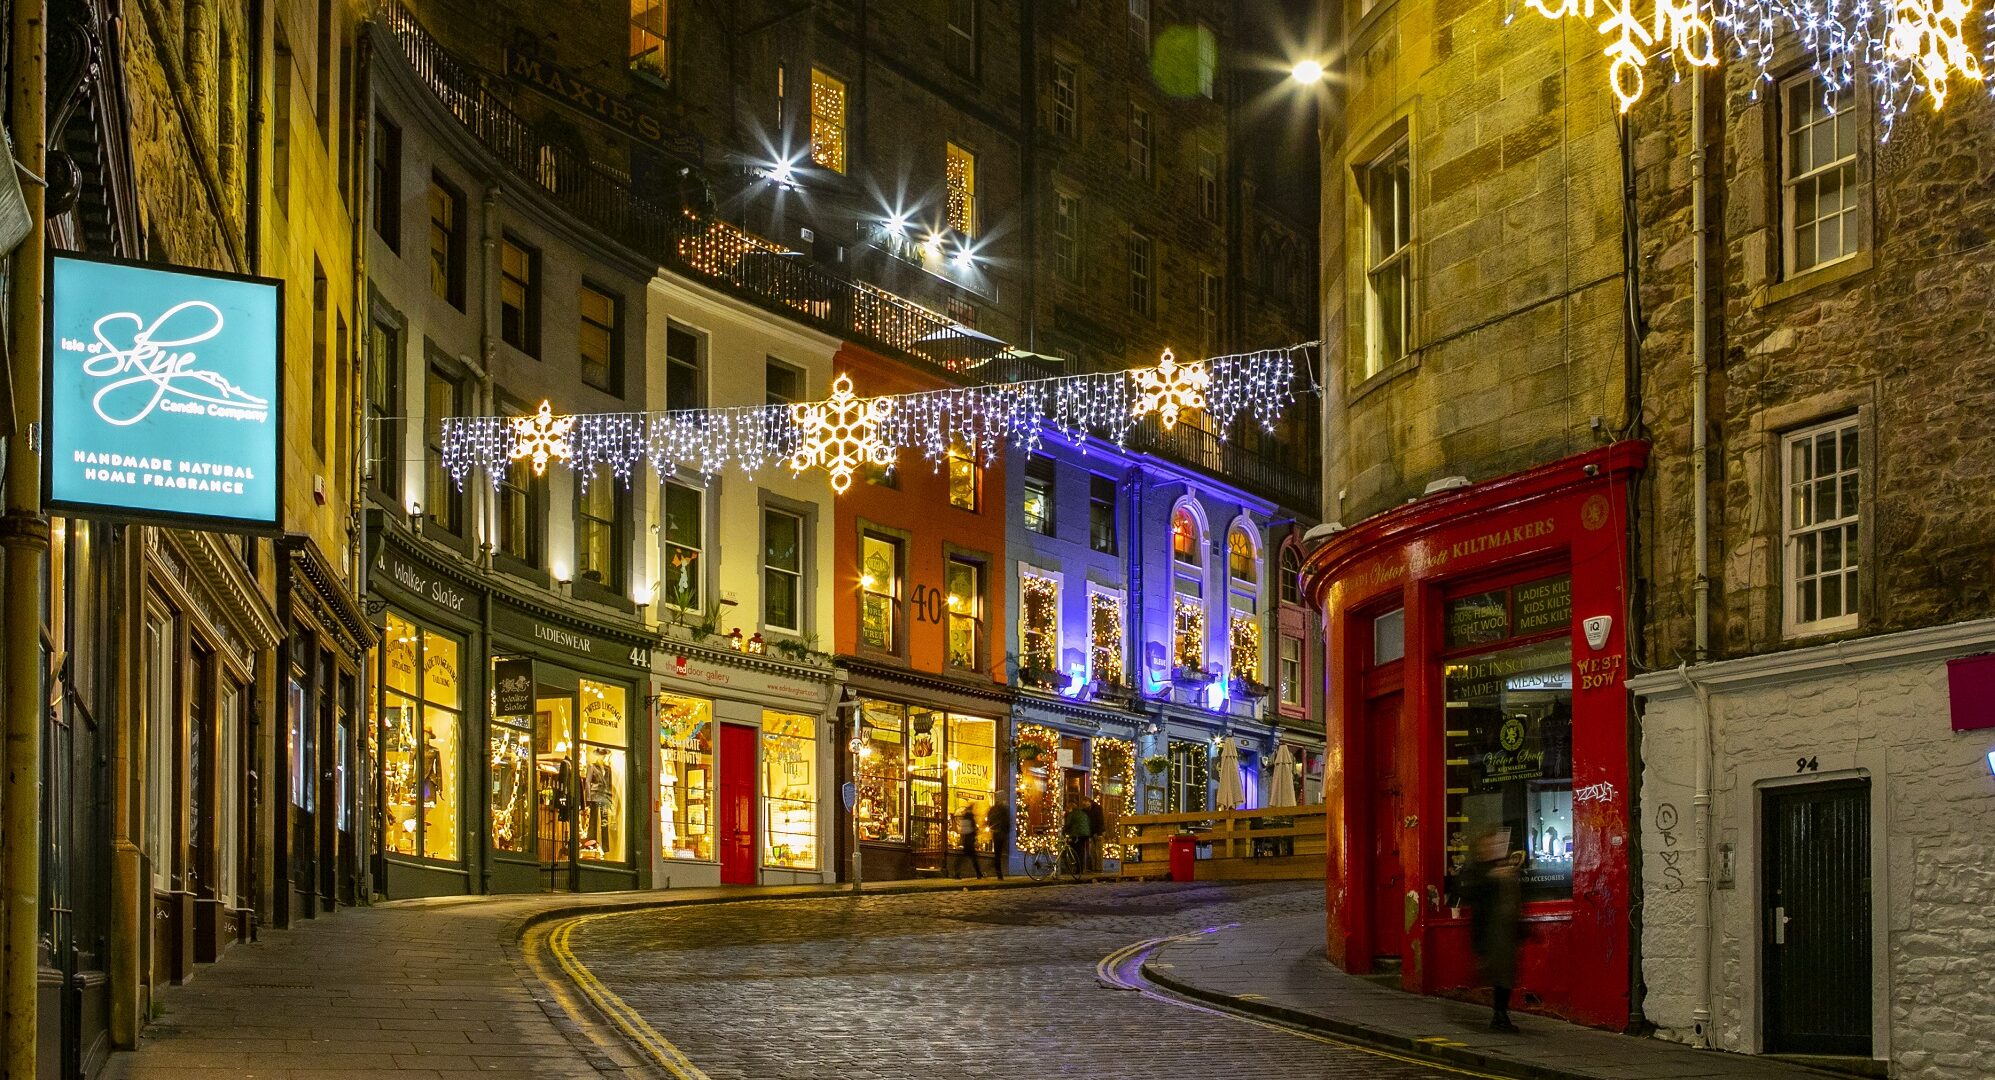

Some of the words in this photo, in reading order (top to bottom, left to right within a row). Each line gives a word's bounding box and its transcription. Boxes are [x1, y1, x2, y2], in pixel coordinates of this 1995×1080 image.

[513, 52, 661, 141] MAXIES
[61, 337, 85, 353] Isle
[87, 341, 103, 354] of
[83, 300, 224, 426] Skye
[159, 399, 205, 416] Candle
[207, 404, 268, 423] Company
[74, 450, 173, 472] HANDMADE
[179, 460, 255, 480] NATURAL
[85, 467, 136, 485] HOME
[143, 473, 244, 495] FRAGRANCE
[1452, 517, 1556, 559] KILTMAKERS
[394, 560, 426, 594] Walker
[432, 581, 464, 612] Slater
[1518, 585, 1550, 602] LADIES
[1553, 580, 1571, 595] KILT
[911, 584, 942, 624] 40
[1523, 602, 1544, 614] KIDS
[1547, 594, 1571, 609] KILTS
[1452, 621, 1478, 637] EIGHT
[1481, 616, 1508, 630] WOOL
[1520, 615, 1548, 629] MENS
[535, 624, 592, 652] LADIESWEAR
[665, 660, 677, 671] the
[676, 663, 687, 675] red
[687, 665, 703, 677] door
[706, 668, 730, 683] gallery
[1489, 660, 1502, 675] IN
[1577, 654, 1622, 675] WEST
[1461, 683, 1492, 698] MADE
[1512, 673, 1564, 689] MEASURE
[1582, 670, 1616, 689] BOW
[584, 701, 601, 716] TWEED
[955, 762, 988, 779] MUSEUM
[1796, 755, 1818, 773] 94
[960, 776, 982, 785] CONTEXT
[1531, 874, 1565, 882] ACCESORIES
